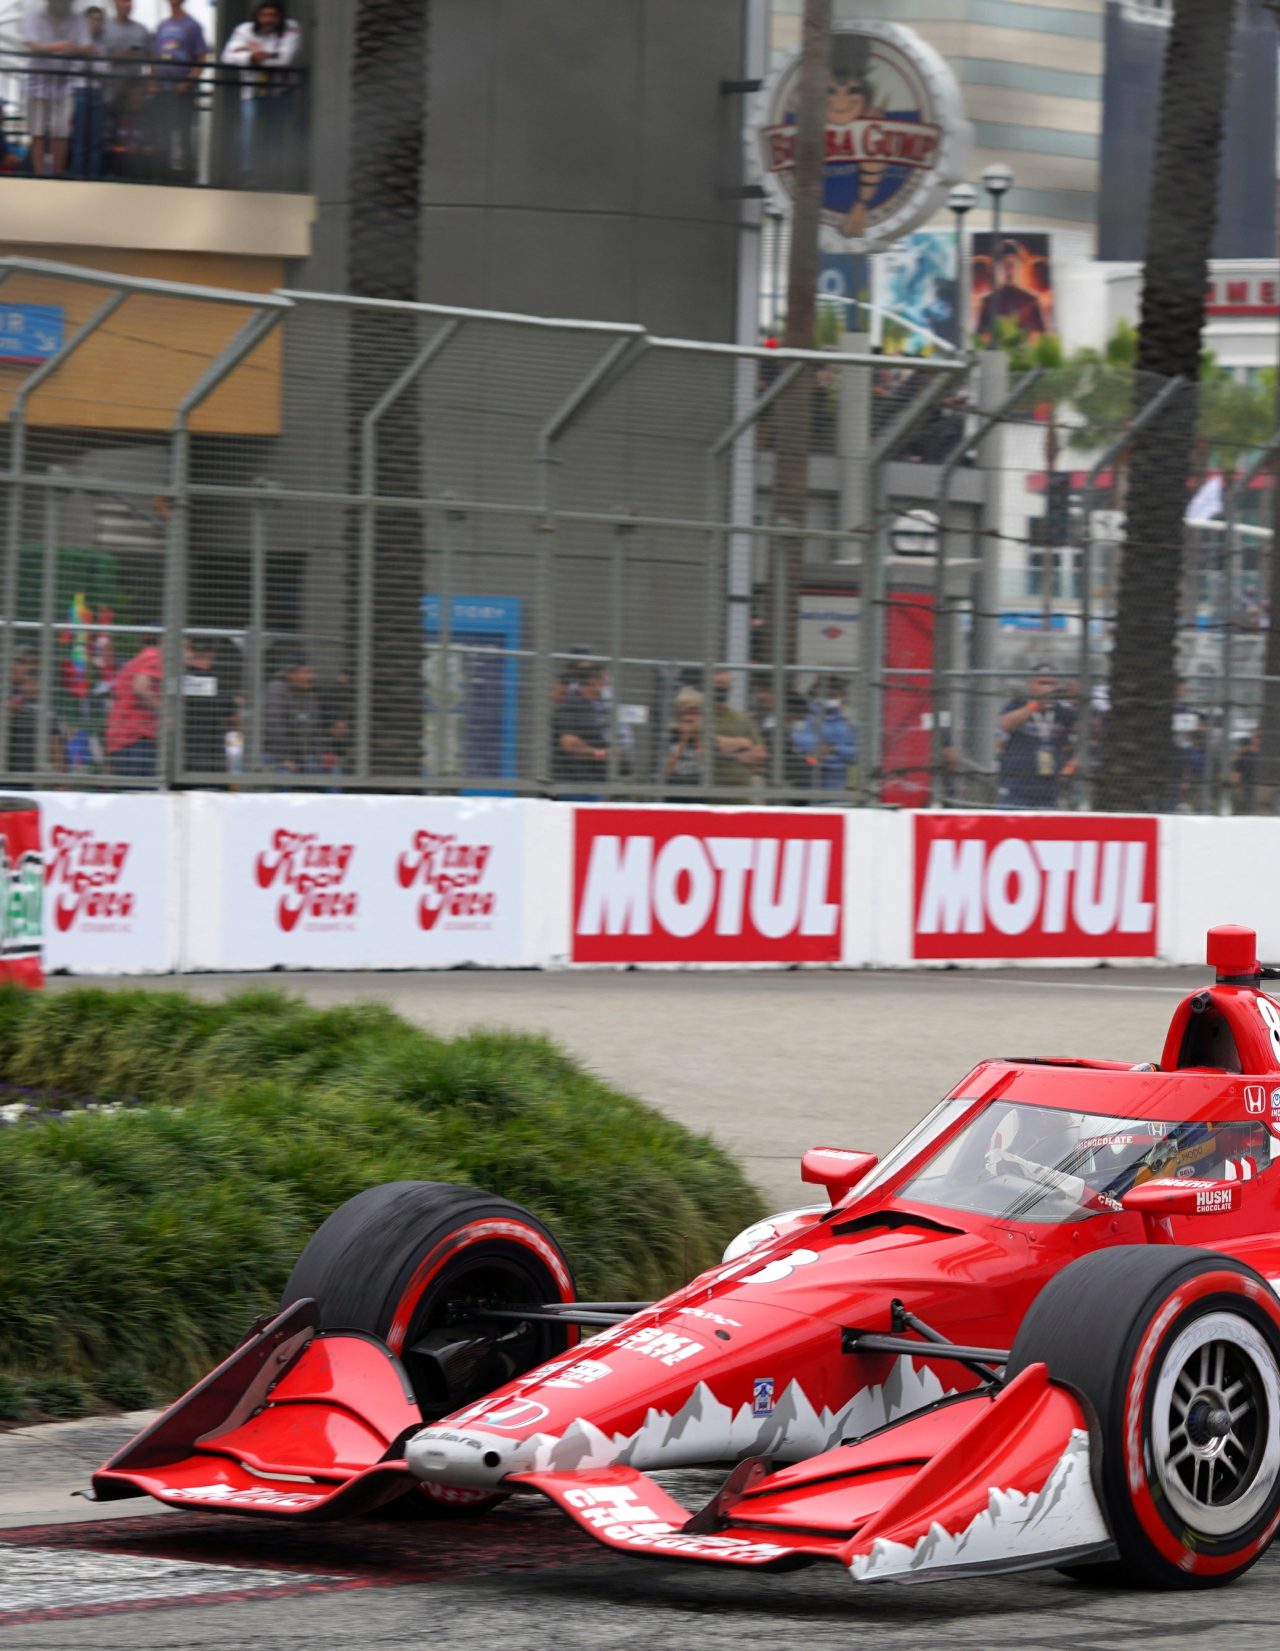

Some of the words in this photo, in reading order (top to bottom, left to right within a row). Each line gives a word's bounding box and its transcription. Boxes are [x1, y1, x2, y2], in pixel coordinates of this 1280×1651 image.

[576, 834, 841, 938] MOTUL
[916, 838, 1155, 935] MOTUL
[1179, 1168, 1195, 1176] BELL
[1196, 1189, 1232, 1206] HUSKI
[1196, 1203, 1232, 1213] CHOCOLATE
